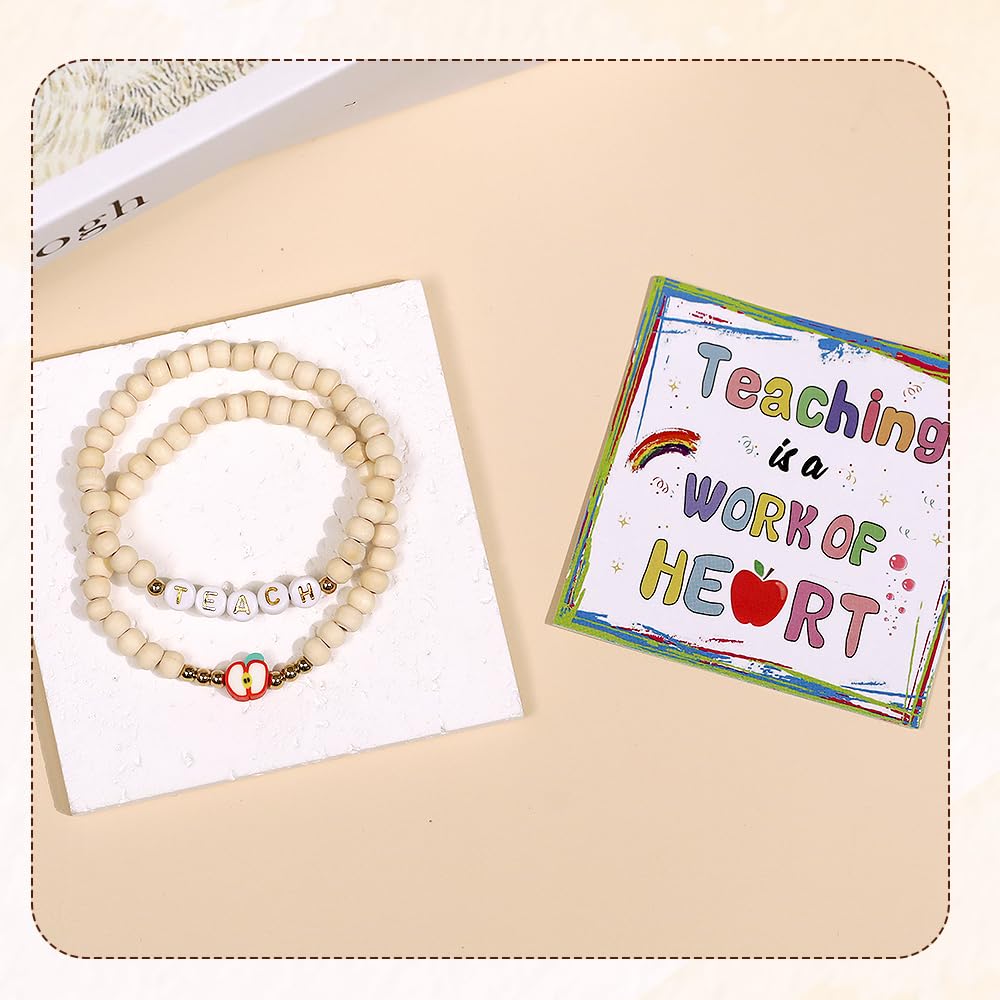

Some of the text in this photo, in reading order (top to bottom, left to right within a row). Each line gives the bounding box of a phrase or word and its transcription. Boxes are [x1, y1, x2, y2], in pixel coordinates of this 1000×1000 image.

[36, 195, 150, 257] ogh
[697, 342, 949, 464] Teaching
[769, 438, 829, 480] is a
[683, 472, 887, 566] WORK OF
[173, 582, 315, 616] TEACH
[639, 538, 880, 658] HERT
